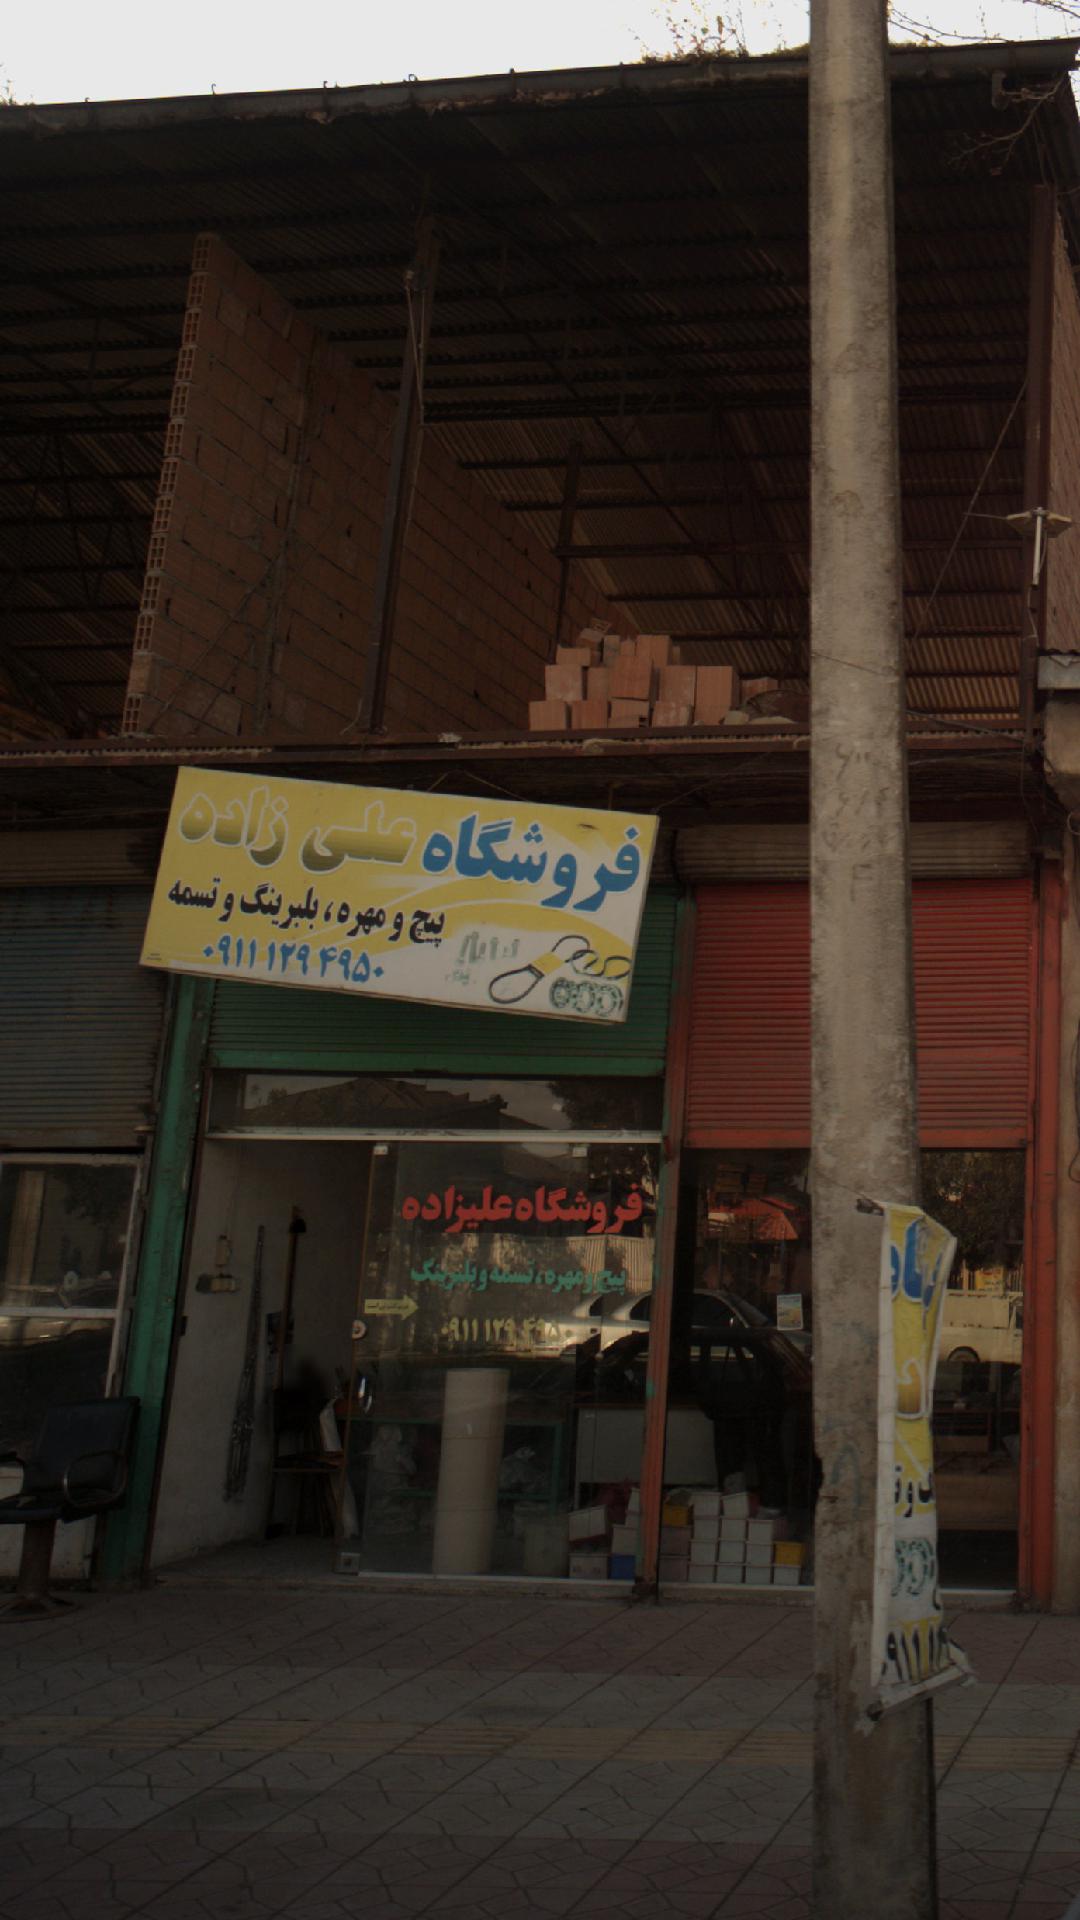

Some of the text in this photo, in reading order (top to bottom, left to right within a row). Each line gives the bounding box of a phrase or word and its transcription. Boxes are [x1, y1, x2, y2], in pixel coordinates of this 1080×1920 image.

[179, 786, 289, 868] زاده
[422, 813, 641, 912] فروشگاه
[168, 877, 221, 908] تسمه
[218, 892, 234, 922] و
[240, 883, 319, 929] بلبرینگ
[388, 910, 404, 941] و
[409, 909, 445, 948] پیچ
[401, 1182, 643, 1234] فروشگاه علیزاده
[582, 1270, 594, 1293] و
[597, 1267, 627, 1295] پیچ
